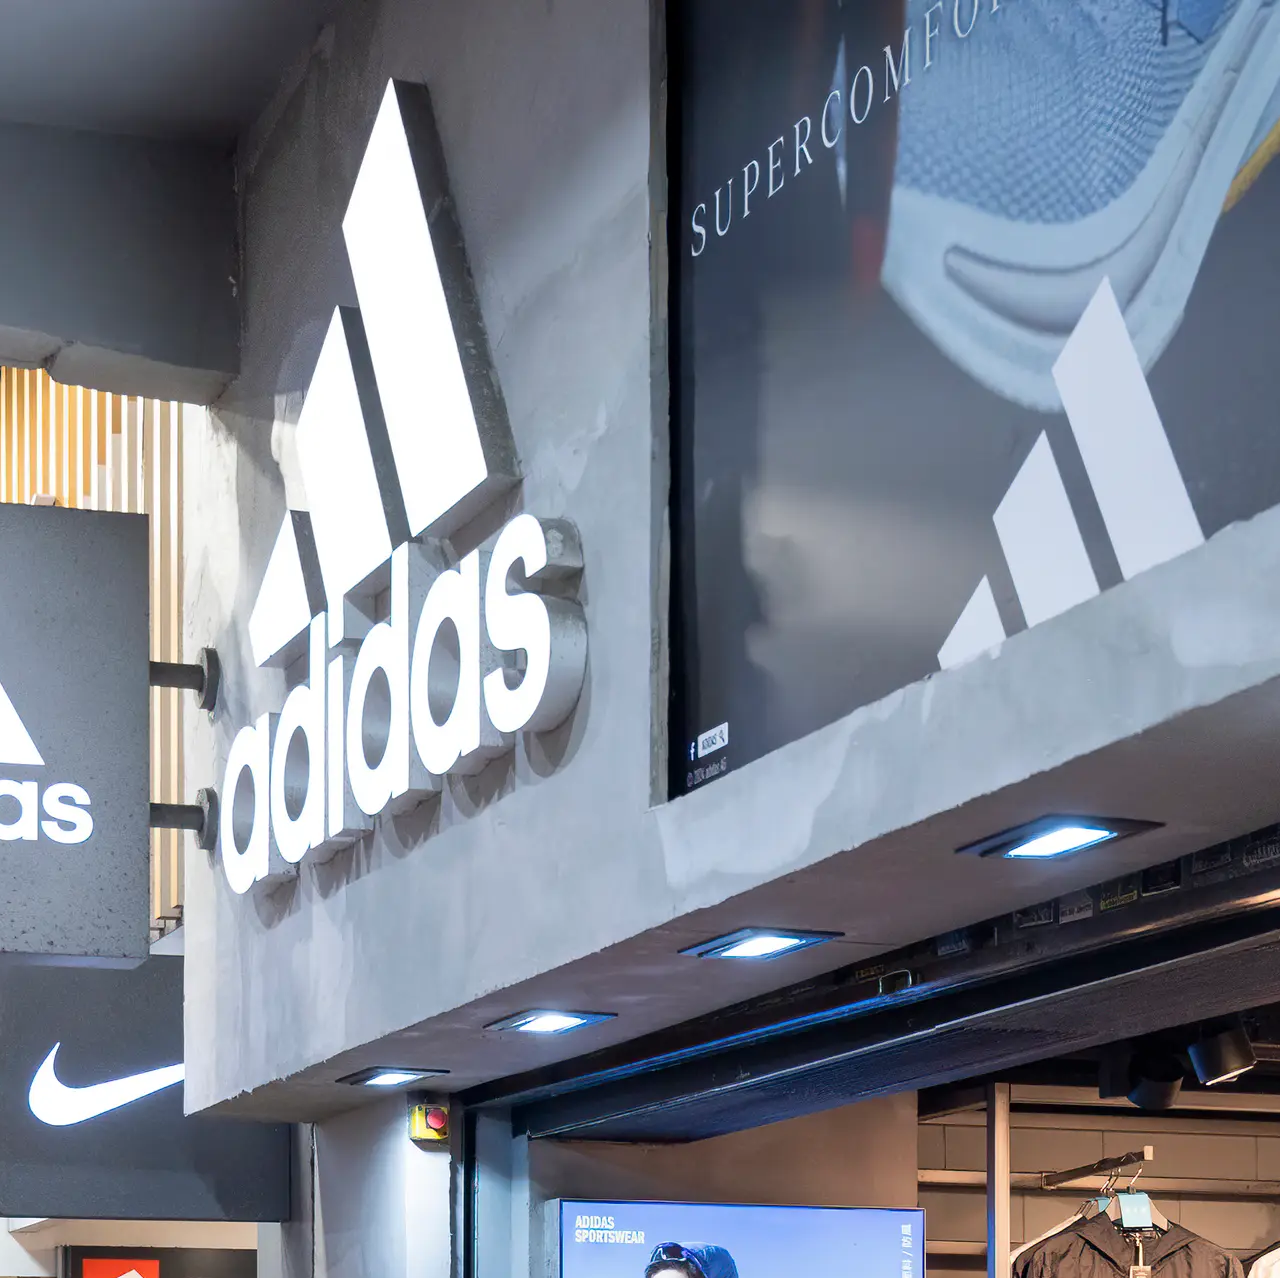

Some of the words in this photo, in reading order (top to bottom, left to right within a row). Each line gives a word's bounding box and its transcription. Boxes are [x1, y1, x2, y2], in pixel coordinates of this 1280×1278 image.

[691, 0, 1001, 257] SUPERCOMFO
[221, 514, 555, 894] adidas
[575, 1215, 615, 1230] ADIDAS
[575, 1229, 645, 1244] SPORTSWEAR
